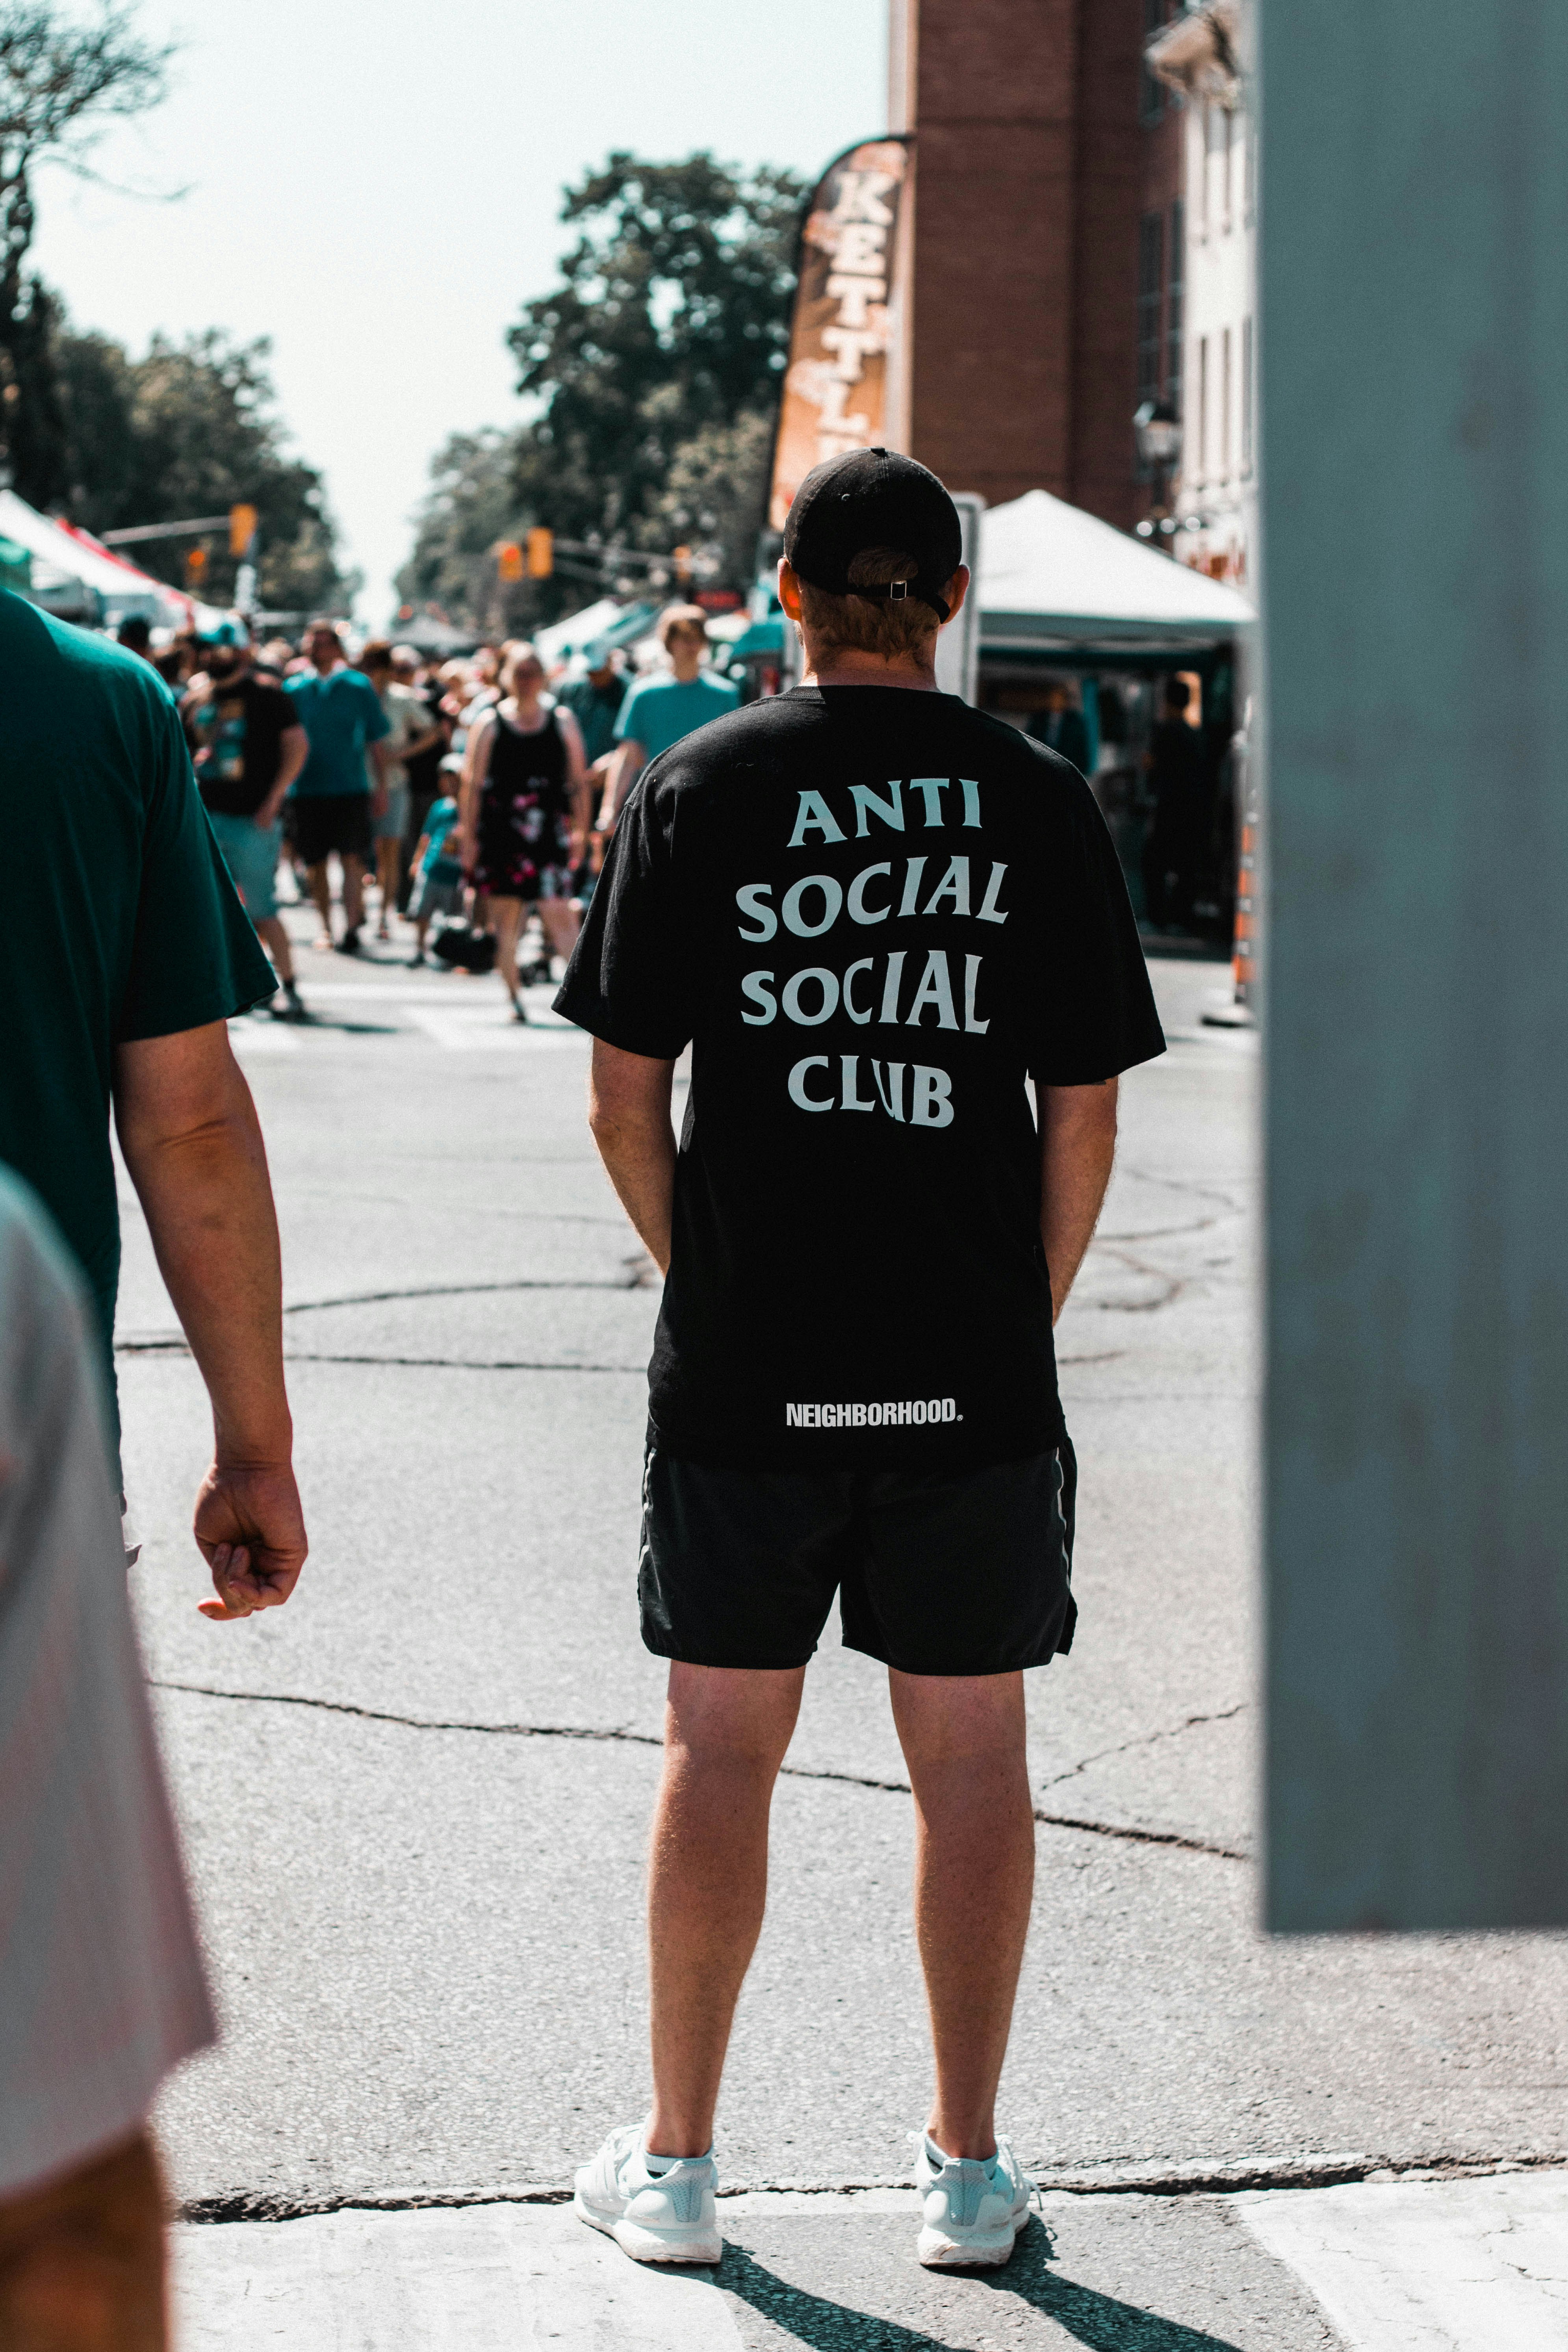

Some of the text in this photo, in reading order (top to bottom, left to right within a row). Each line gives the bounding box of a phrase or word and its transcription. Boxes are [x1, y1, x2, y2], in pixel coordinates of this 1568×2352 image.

[787, 778, 982, 847] ANTI
[736, 856, 1009, 942] SOCIAL
[740, 950, 991, 1034] SOCIAL
[788, 1055, 954, 1128] CLUB
